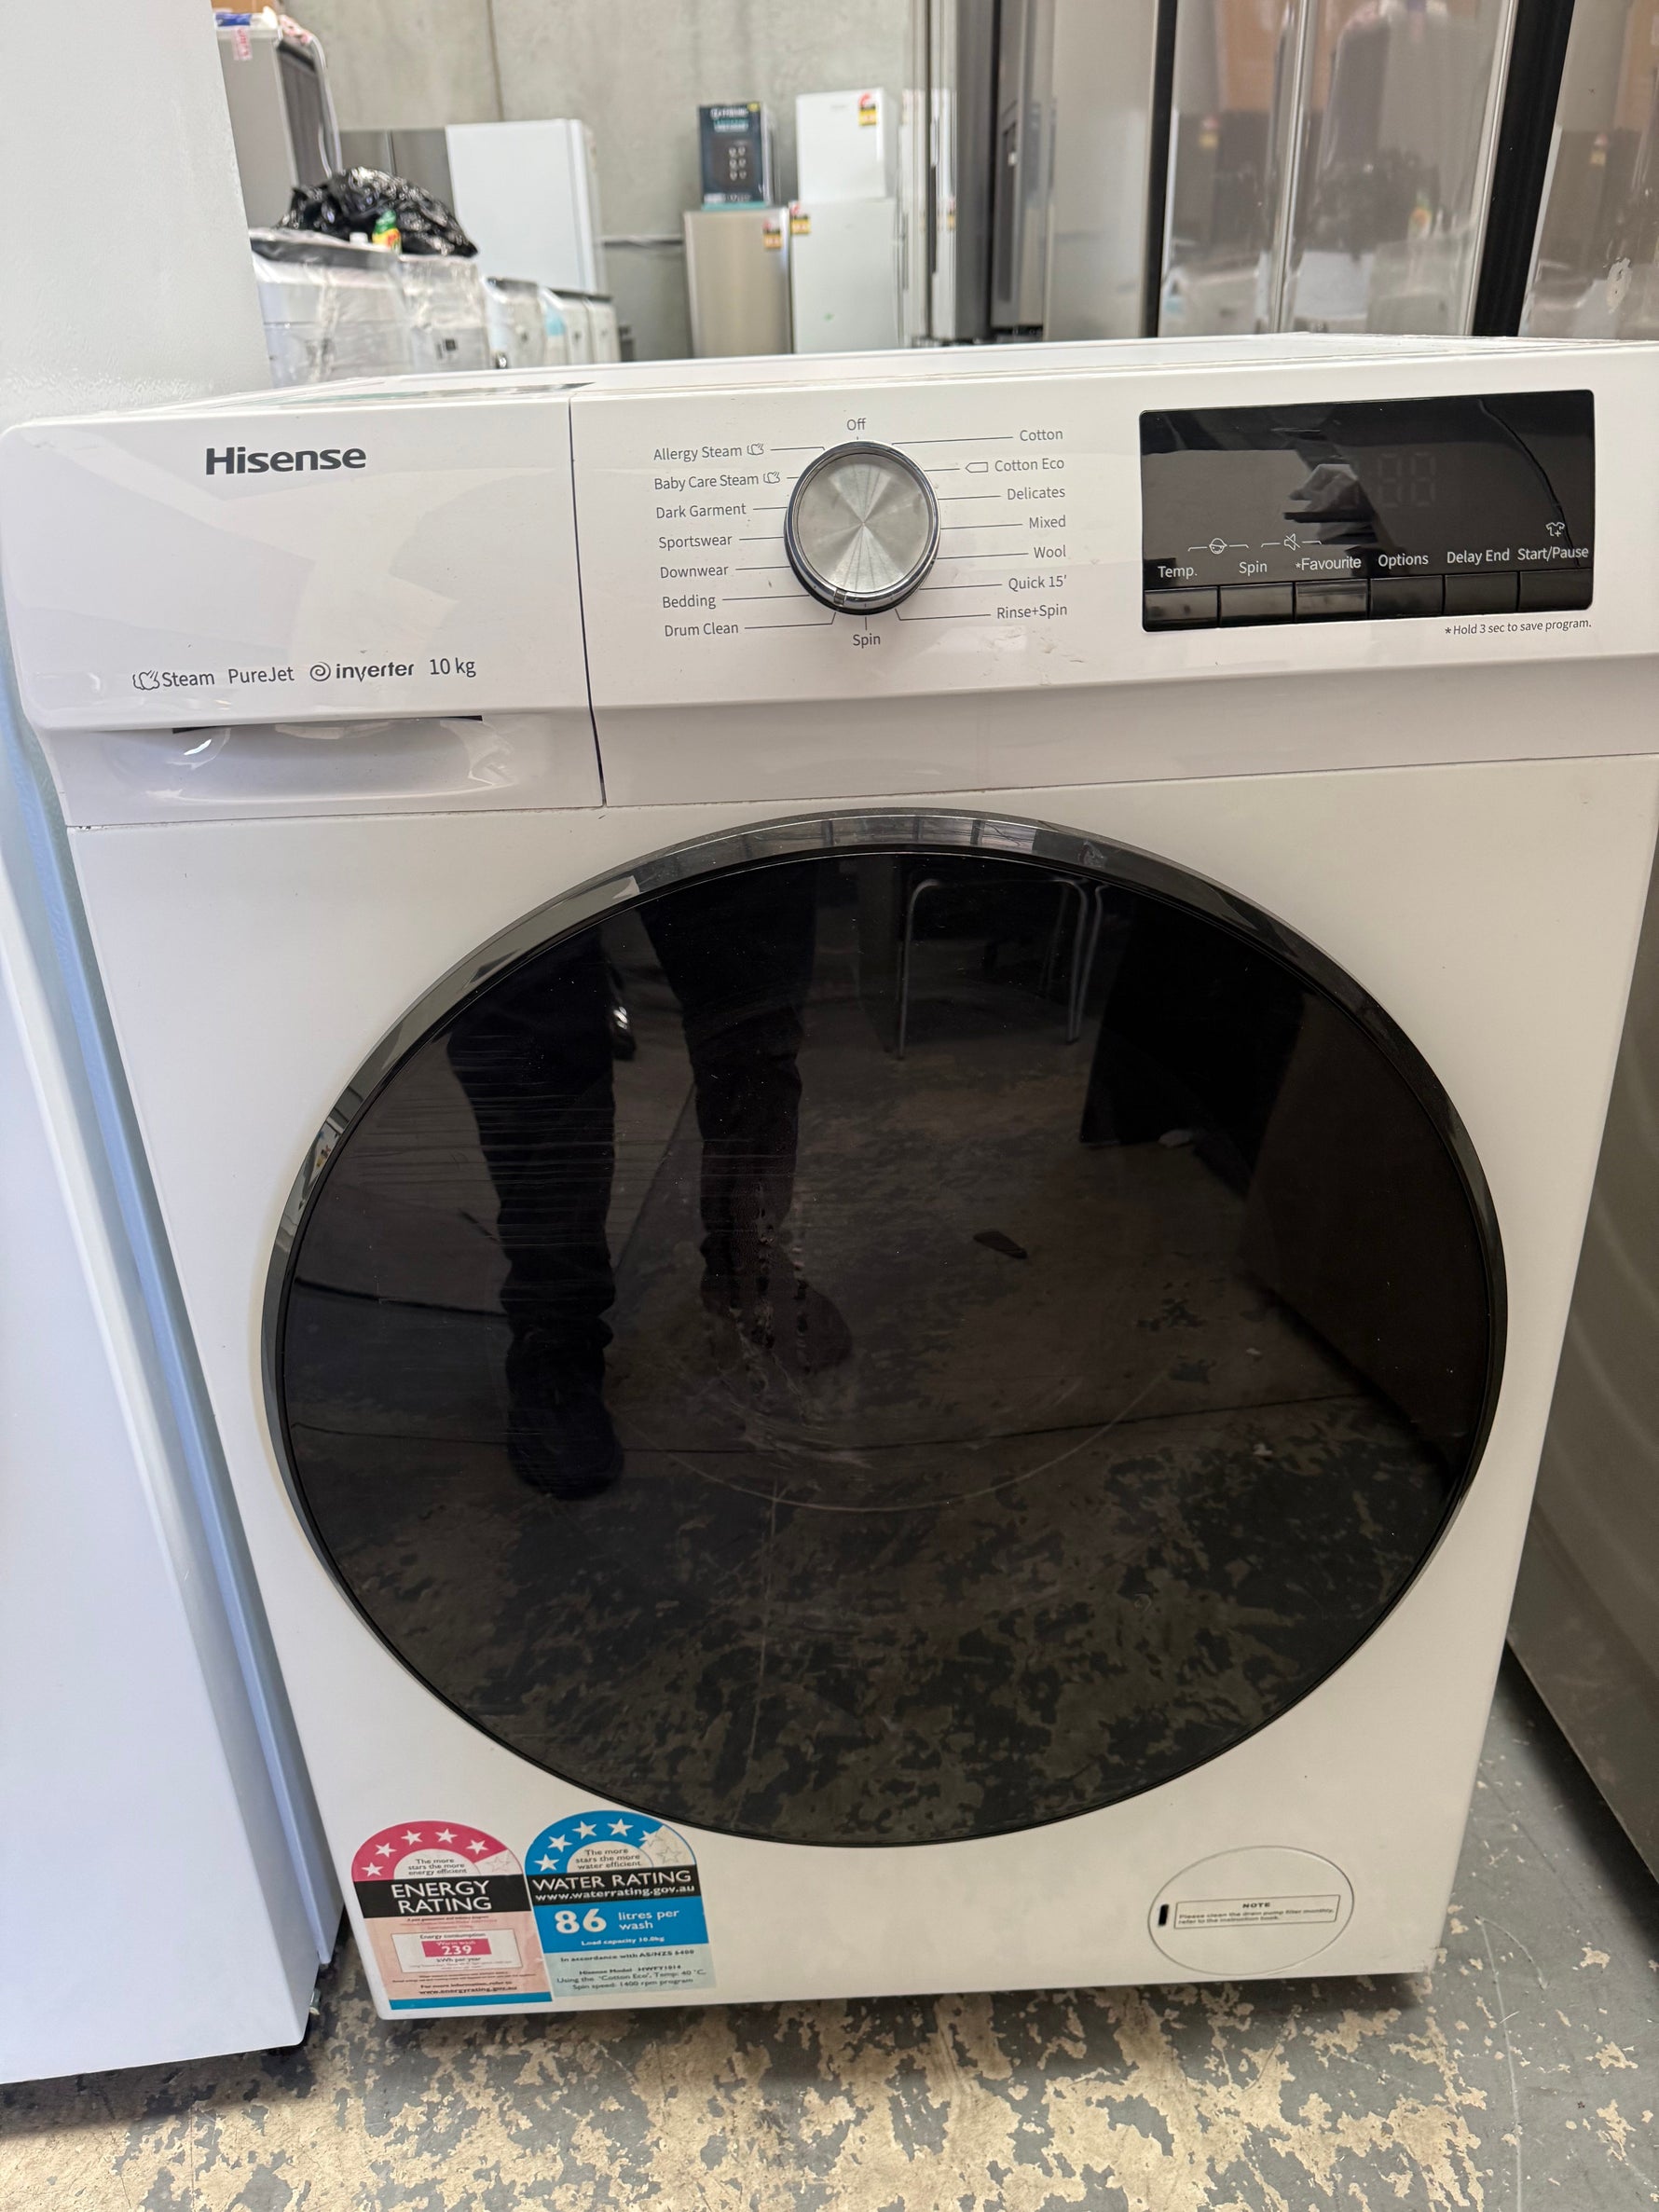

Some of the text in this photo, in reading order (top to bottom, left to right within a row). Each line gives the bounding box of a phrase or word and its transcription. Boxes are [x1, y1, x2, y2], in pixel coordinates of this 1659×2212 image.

[847, 418, 866, 431] Off
[1020, 429, 1063, 441] Cotton
[206, 447, 365, 474] Hisense
[653, 445, 742, 461] Allergy Steam
[994, 458, 1064, 472] Cotton Eco
[654, 474, 759, 491] Baby Care Steam
[1007, 486, 1065, 501] Delicates
[656, 503, 746, 519] Dark Garment
[1029, 515, 1065, 529] Mixed
[659, 534, 733, 552] Sportswear
[1034, 545, 1066, 558] Wool
[1446, 549, 1510, 566] Delay End
[1517, 545, 1589, 561] Start/Pause
[1239, 560, 1268, 577] Spin
[1378, 552, 1429, 569] Options
[660, 564, 728, 578] Downwear
[1158, 565, 1197, 579] Temp.
[1008, 574, 1067, 592] Quick 15'
[663, 595, 716, 610] Bedding
[997, 604, 1067, 620] Rinse+Spin
[665, 621, 738, 638] Drum Clean
[1479, 624, 1486, 635] 3
[1488, 625, 1505, 634] sec
[1508, 624, 1517, 632] to
[1544, 619, 1591, 632] program.
[853, 632, 881, 649] Spin
[162, 658, 475, 687] Steam PureJet inverter 10 kg
[533, 1870, 692, 1891] WATER RATING
[391, 1880, 489, 1898] ENERGY
[535, 1885, 694, 1901] www.waterrating.gov.au
[398, 1897, 492, 1914] RATING
[555, 1908, 606, 1934] 86
[619, 1910, 679, 1920] litres per
[619, 1921, 652, 1930] wash
[442, 1945, 472, 1955] 239
